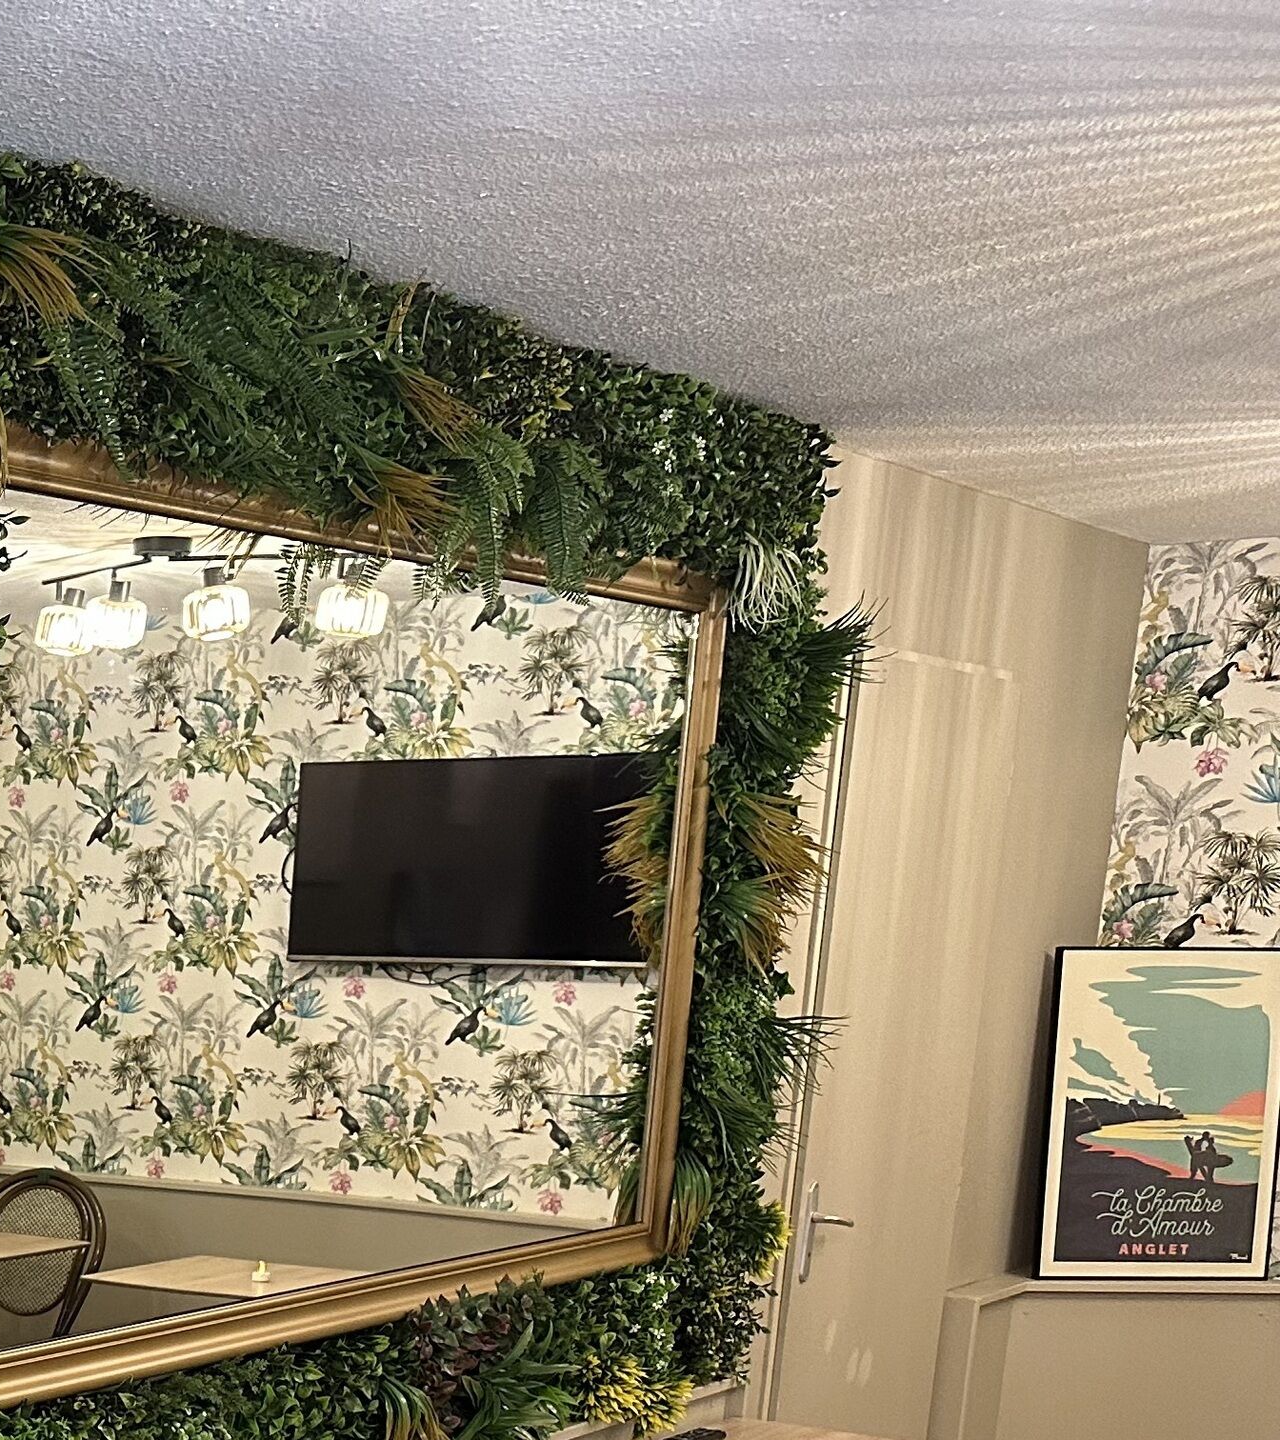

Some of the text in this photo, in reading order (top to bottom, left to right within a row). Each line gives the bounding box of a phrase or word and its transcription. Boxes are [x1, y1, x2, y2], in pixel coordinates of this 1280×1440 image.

[1134, 1185, 1224, 1215] Chambre
[1096, 1209, 1215, 1238] d'Amour
[1118, 1243, 1190, 1255] ANGLET
